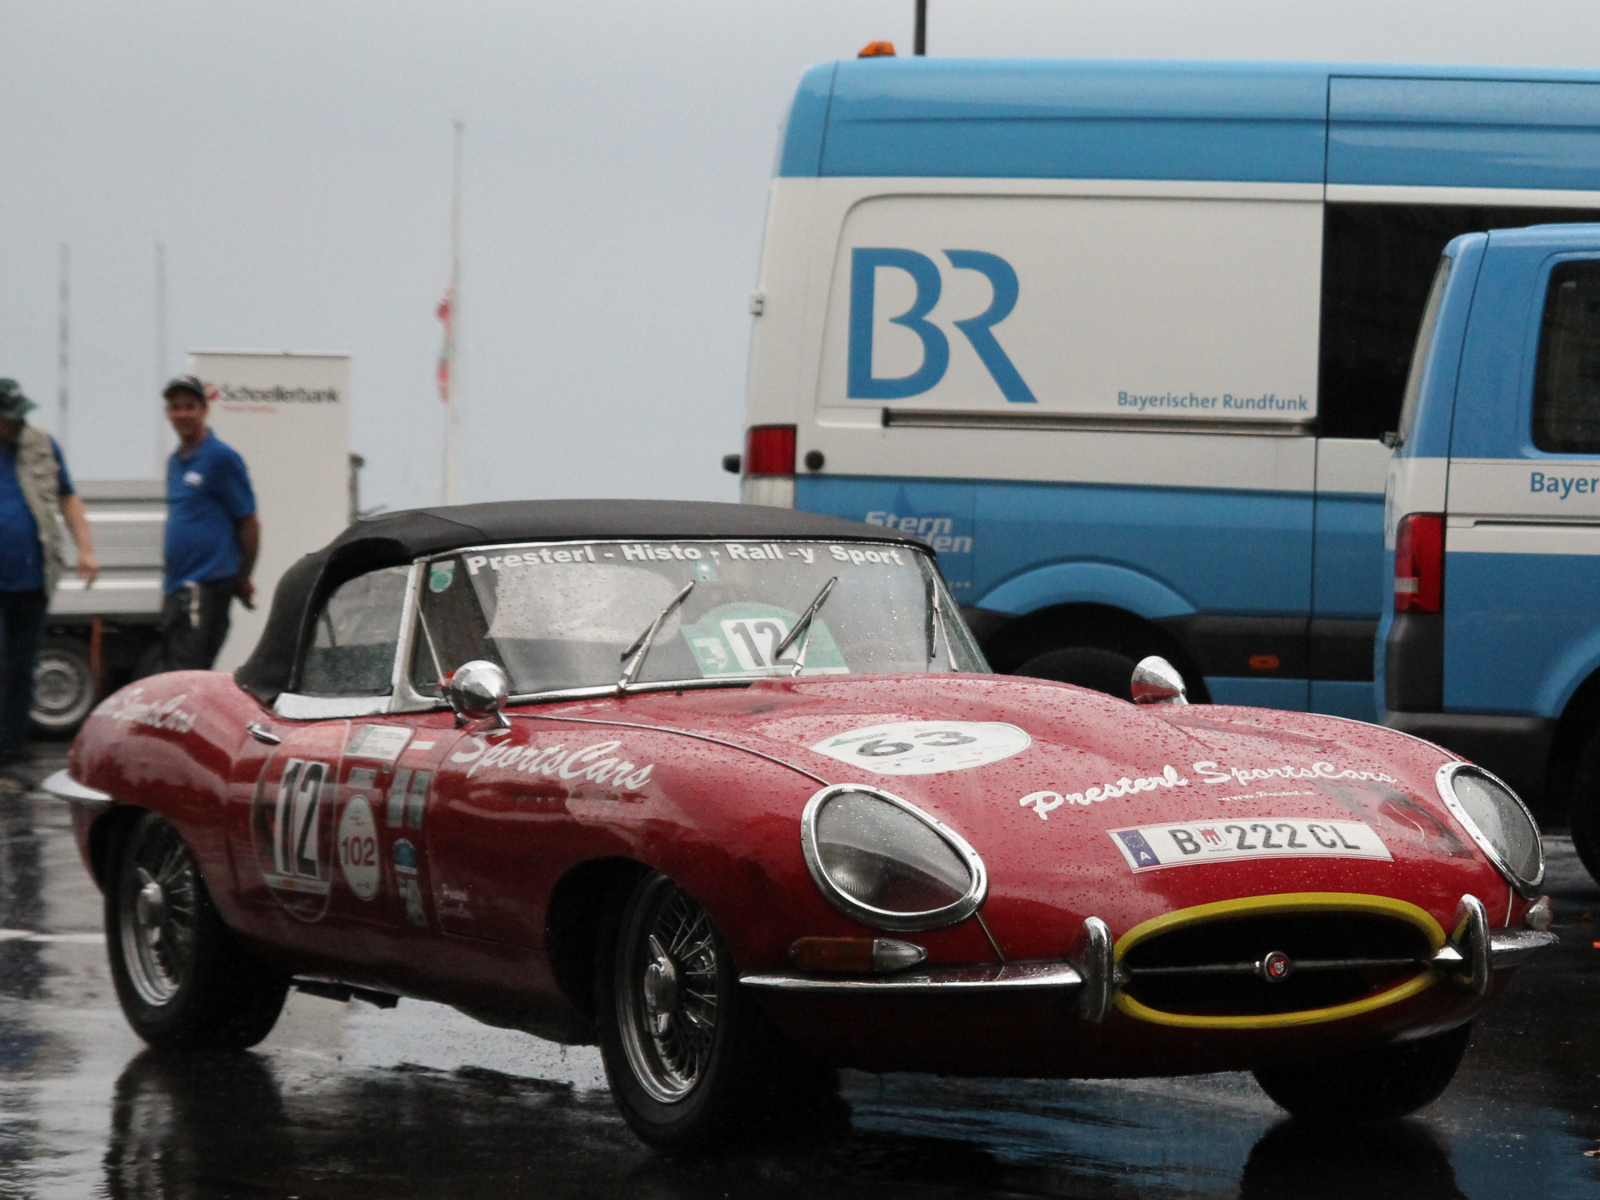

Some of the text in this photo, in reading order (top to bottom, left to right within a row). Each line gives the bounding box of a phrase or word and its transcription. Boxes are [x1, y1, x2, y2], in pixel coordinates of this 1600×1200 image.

[846, 247, 1038, 403] BR
[1117, 391, 1309, 412] Bayerischer Rundfunk
[865, 511, 951, 534] Stern
[467, 546, 596, 575] Presterl
[621, 544, 700, 562] Histo
[830, 544, 904, 566] Sport
[731, 621, 796, 667] 12
[856, 731, 977, 757] 63
[451, 729, 655, 791] SportsCars
[1019, 761, 1398, 820] Presterl SportsCars
[282, 760, 324, 877] 12
[341, 836, 376, 867] 102
[1140, 851, 1151, 863] A
[1168, 829, 1200, 855] B
